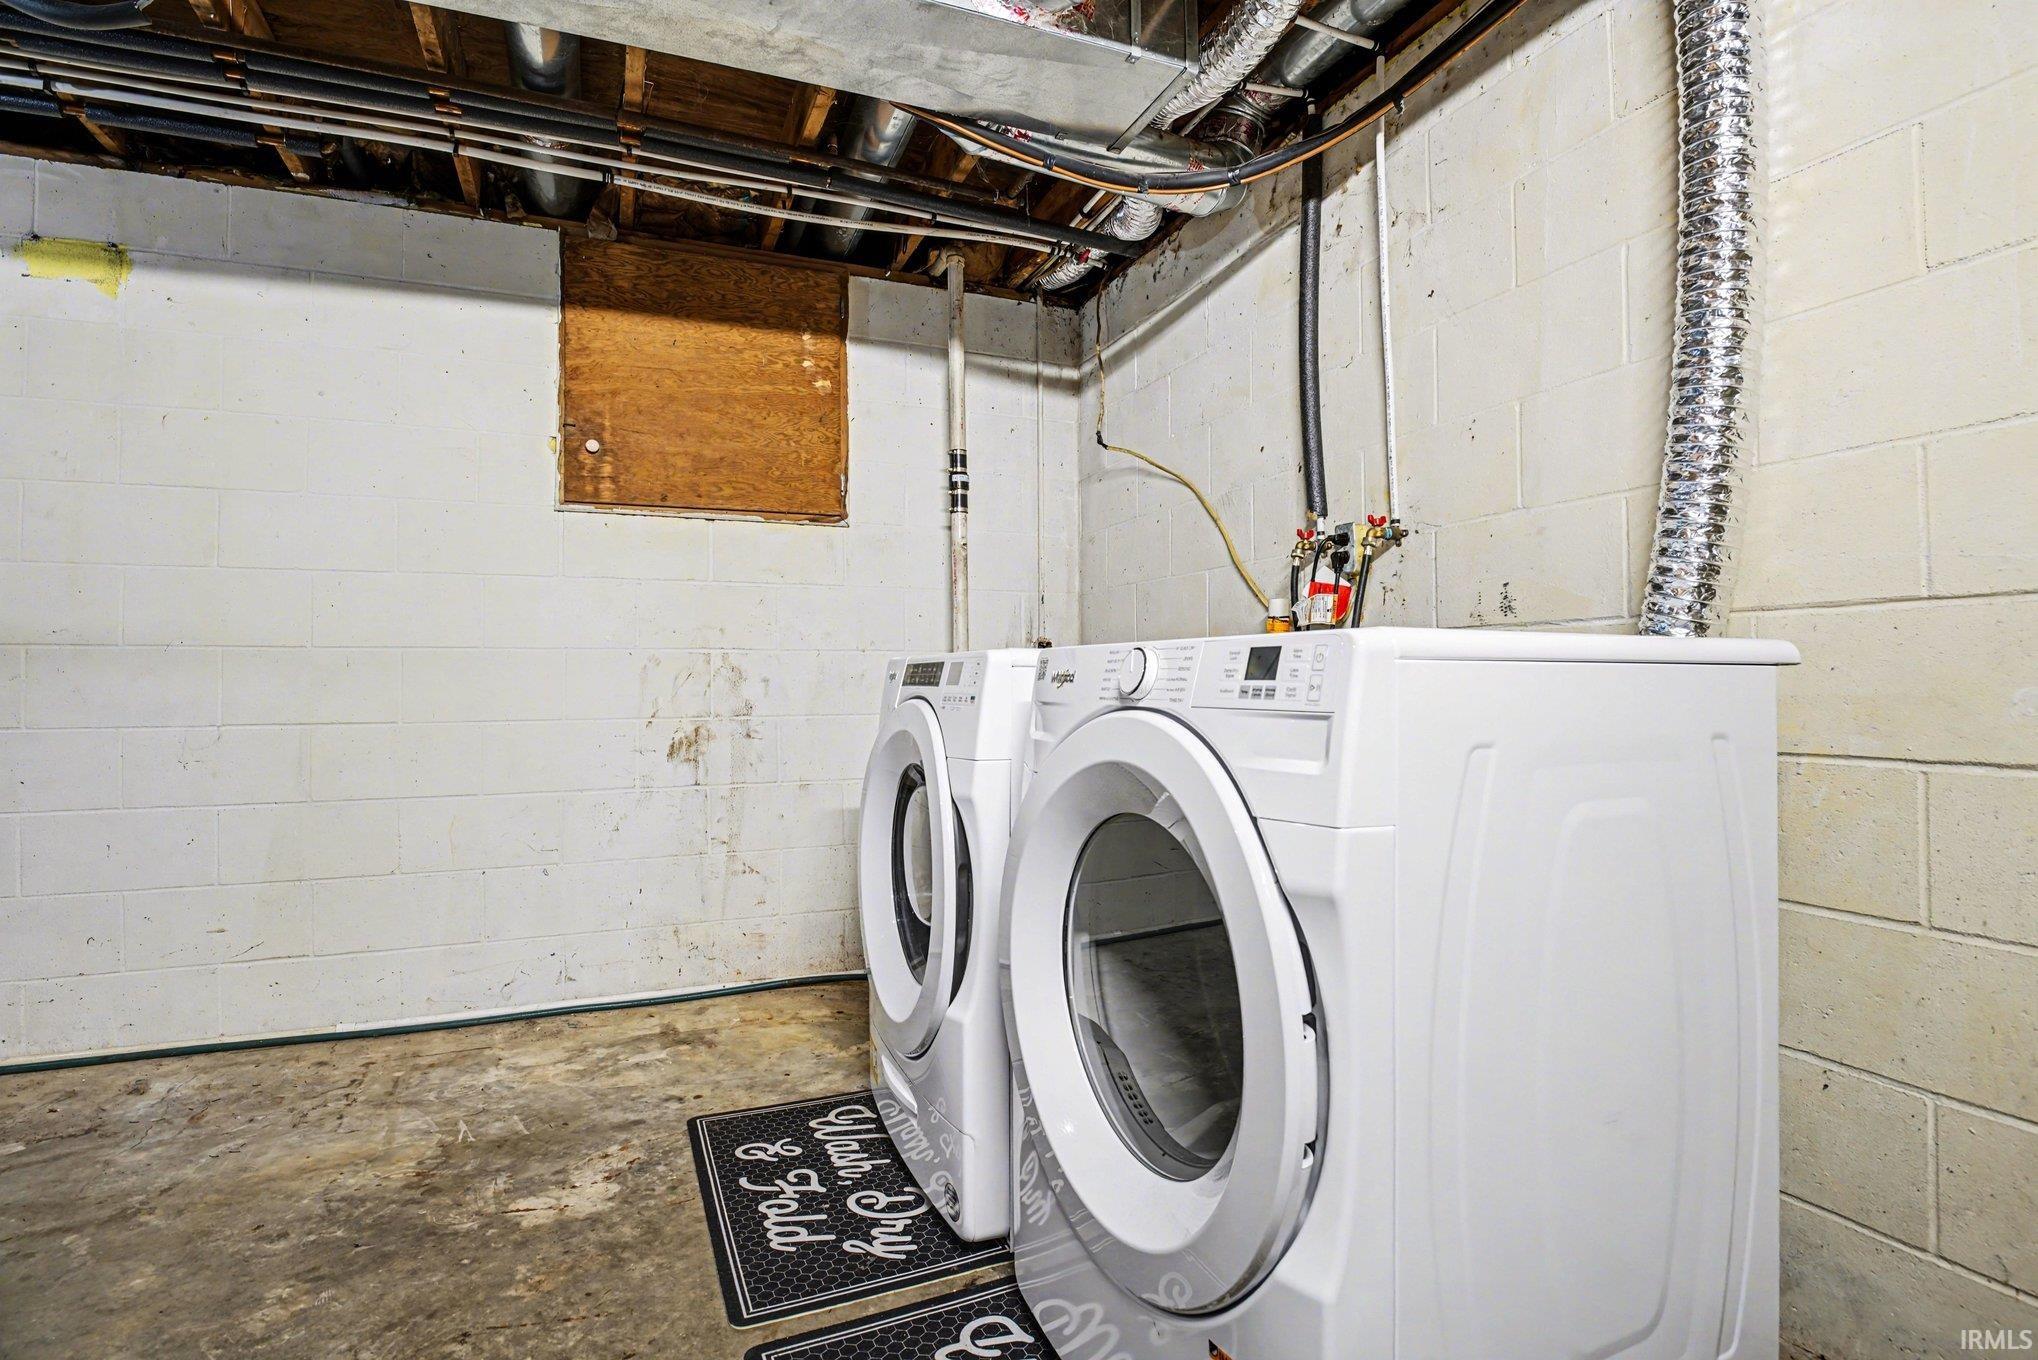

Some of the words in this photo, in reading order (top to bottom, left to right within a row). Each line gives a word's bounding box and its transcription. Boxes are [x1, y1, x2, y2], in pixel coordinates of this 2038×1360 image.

[734, 1137, 803, 1162] &
[738, 1168, 837, 1252] Fold
[842, 1186, 932, 1260] Dry
